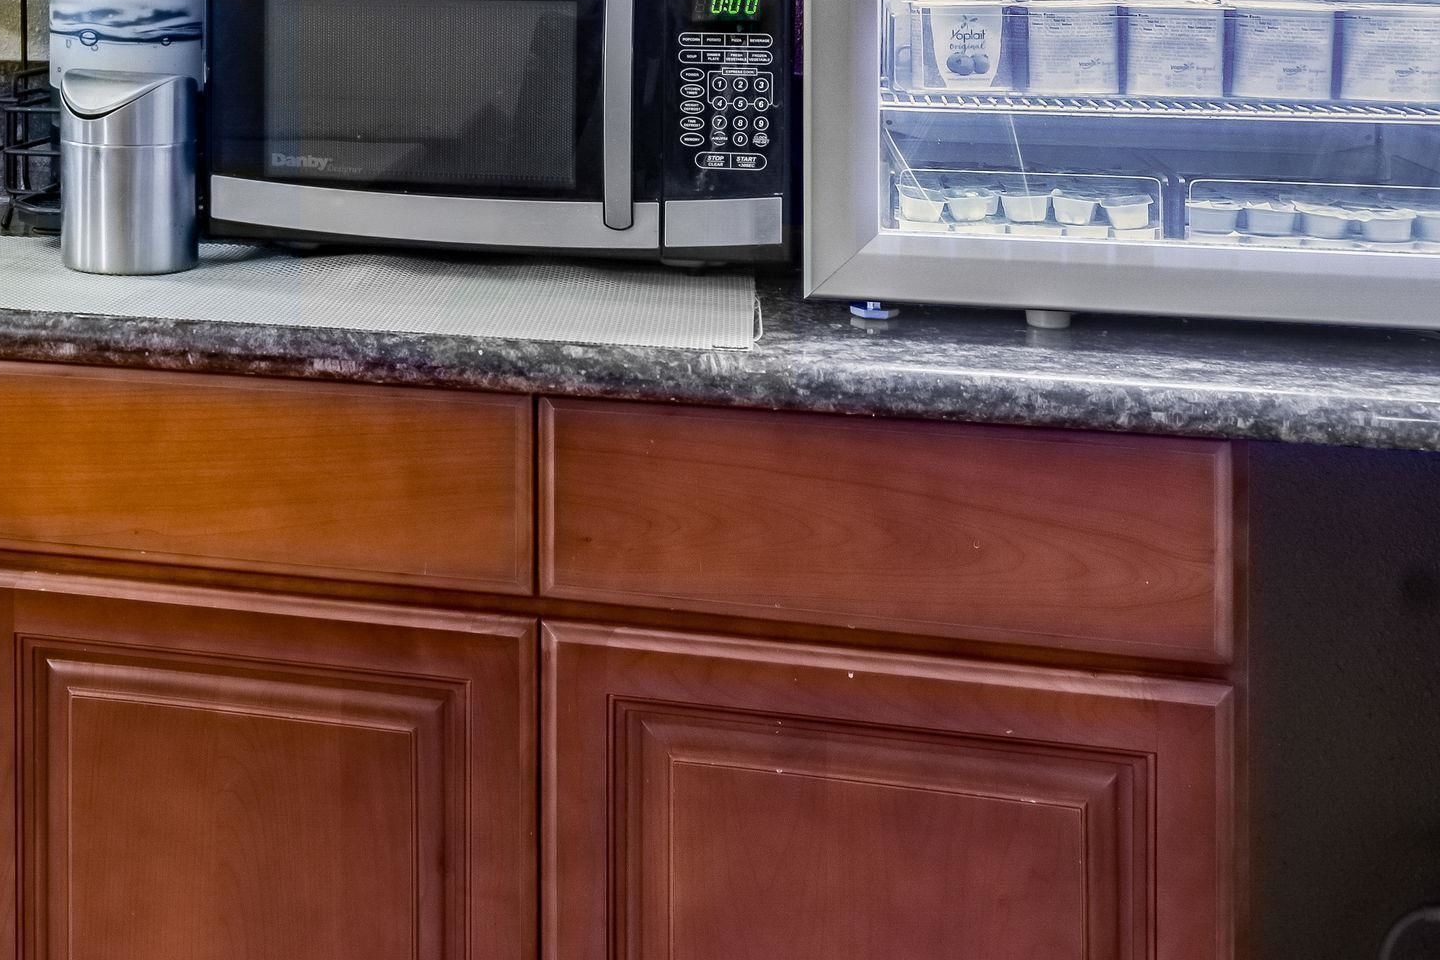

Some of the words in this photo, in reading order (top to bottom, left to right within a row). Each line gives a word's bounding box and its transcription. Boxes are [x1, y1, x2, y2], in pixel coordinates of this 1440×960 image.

[951, 29, 986, 43] Yoplait
[949, 41, 985, 54] Original
[717, 80, 722, 88] 1
[737, 81, 744, 89] 2
[758, 81, 765, 89] 3
[717, 99, 723, 107] 4
[737, 100, 744, 108] 5
[758, 100, 764, 108] 6
[717, 118, 723, 126] 7
[737, 119, 744, 127] 8
[758, 119, 764, 128] 9
[737, 135, 743, 143] 0
[271, 152, 329, 171] Danby
